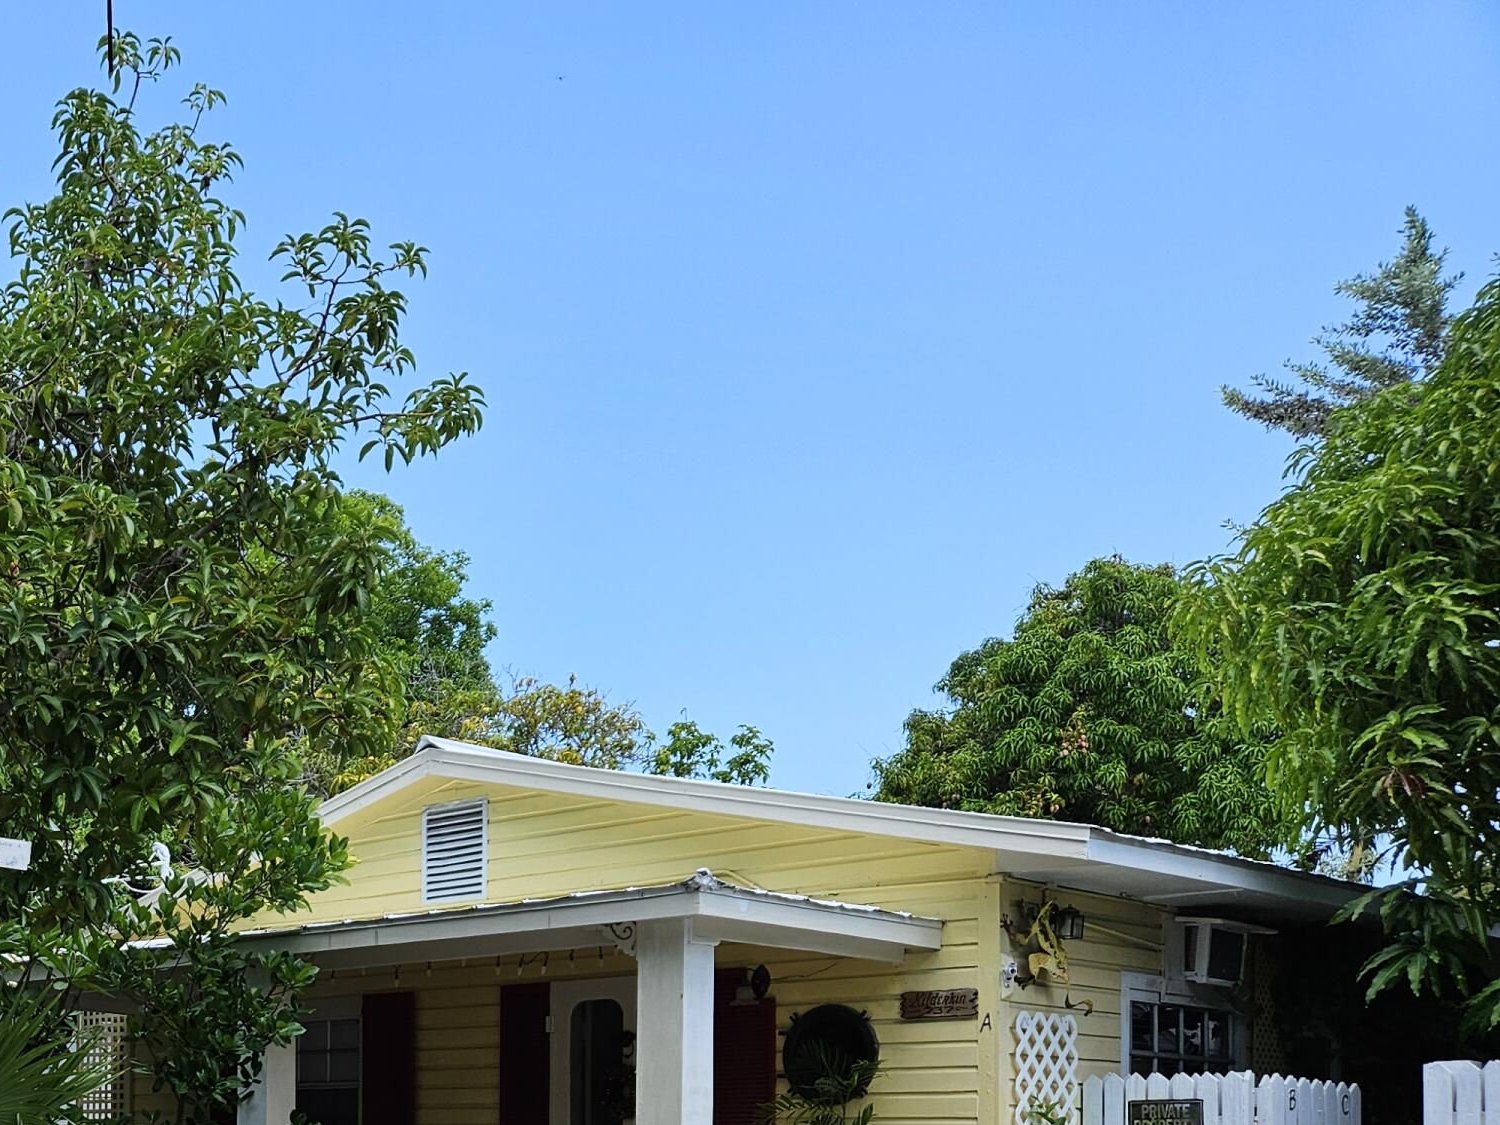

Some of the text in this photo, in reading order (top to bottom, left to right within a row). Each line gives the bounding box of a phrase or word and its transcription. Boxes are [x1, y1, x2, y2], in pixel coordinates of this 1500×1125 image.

[980, 1012, 992, 1033] A
[1288, 1089, 1297, 1111] B
[1341, 1095, 1350, 1116] C
[1141, 1103, 1191, 1119] PRIVATE
